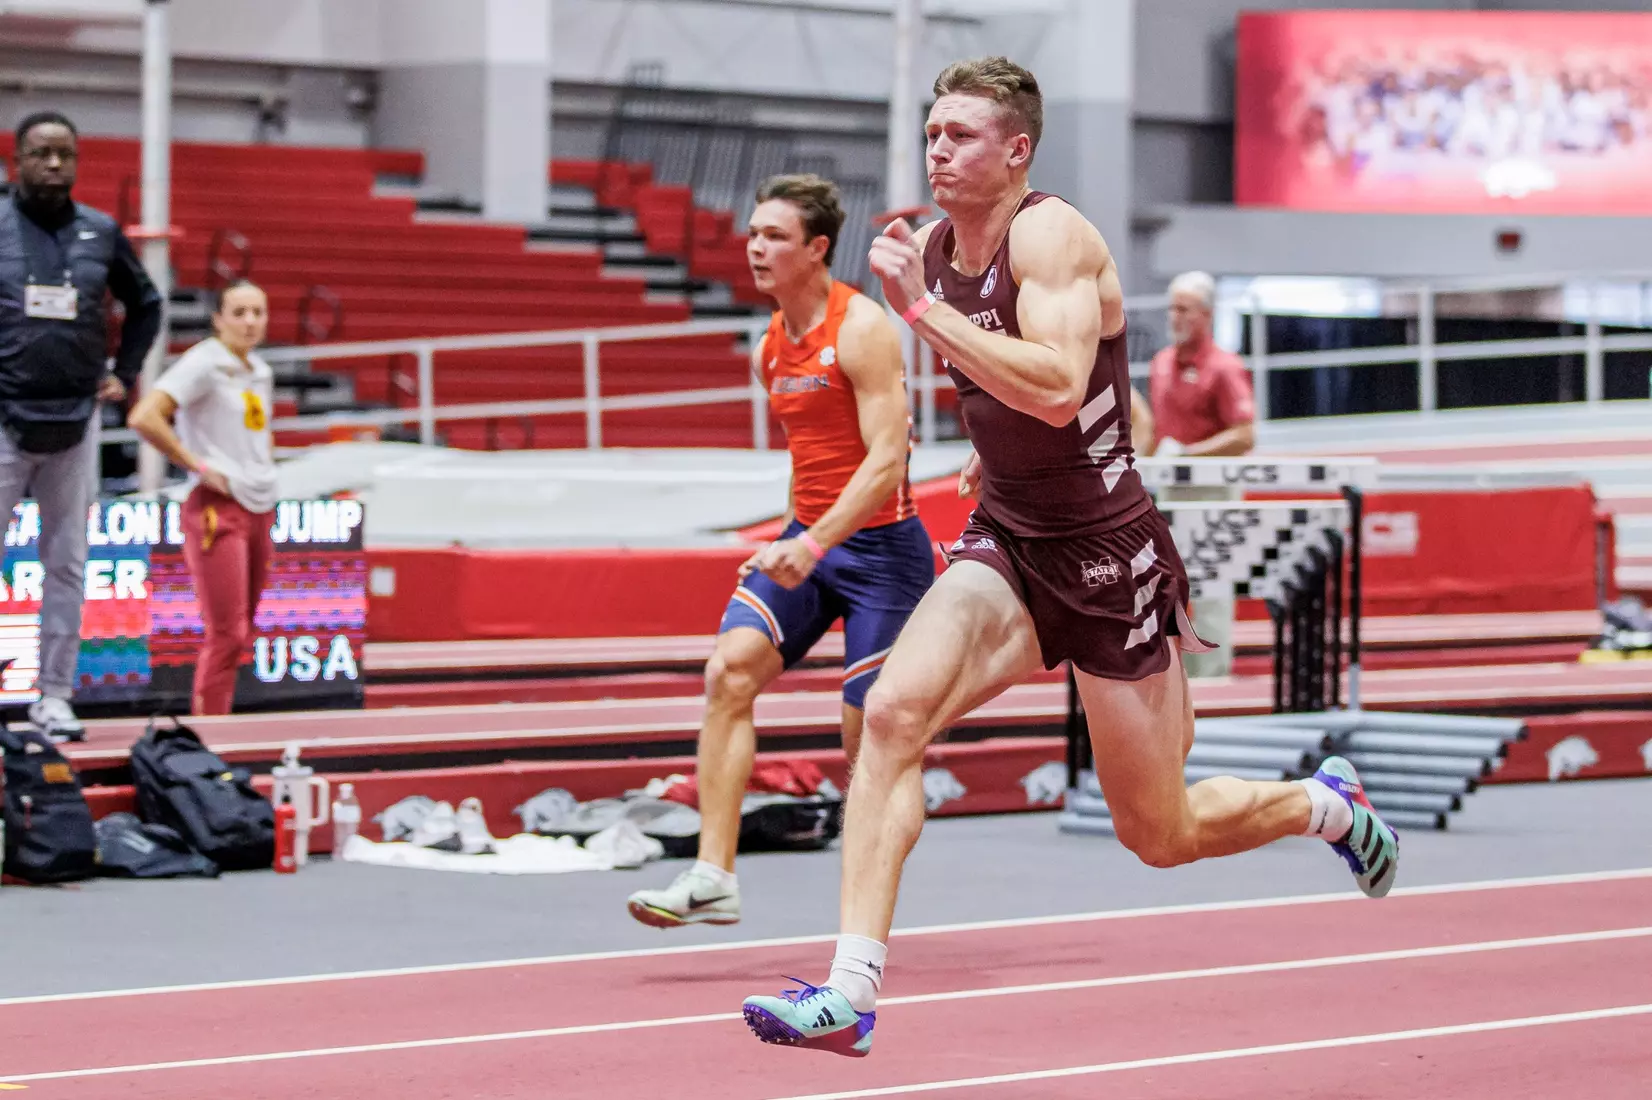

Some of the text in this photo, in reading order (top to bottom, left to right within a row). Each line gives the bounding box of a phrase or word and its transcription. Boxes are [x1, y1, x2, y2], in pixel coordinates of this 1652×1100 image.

[1222, 464, 1278, 483] UCS
[270, 501, 362, 543] JUMP
[255, 635, 358, 682] USA
